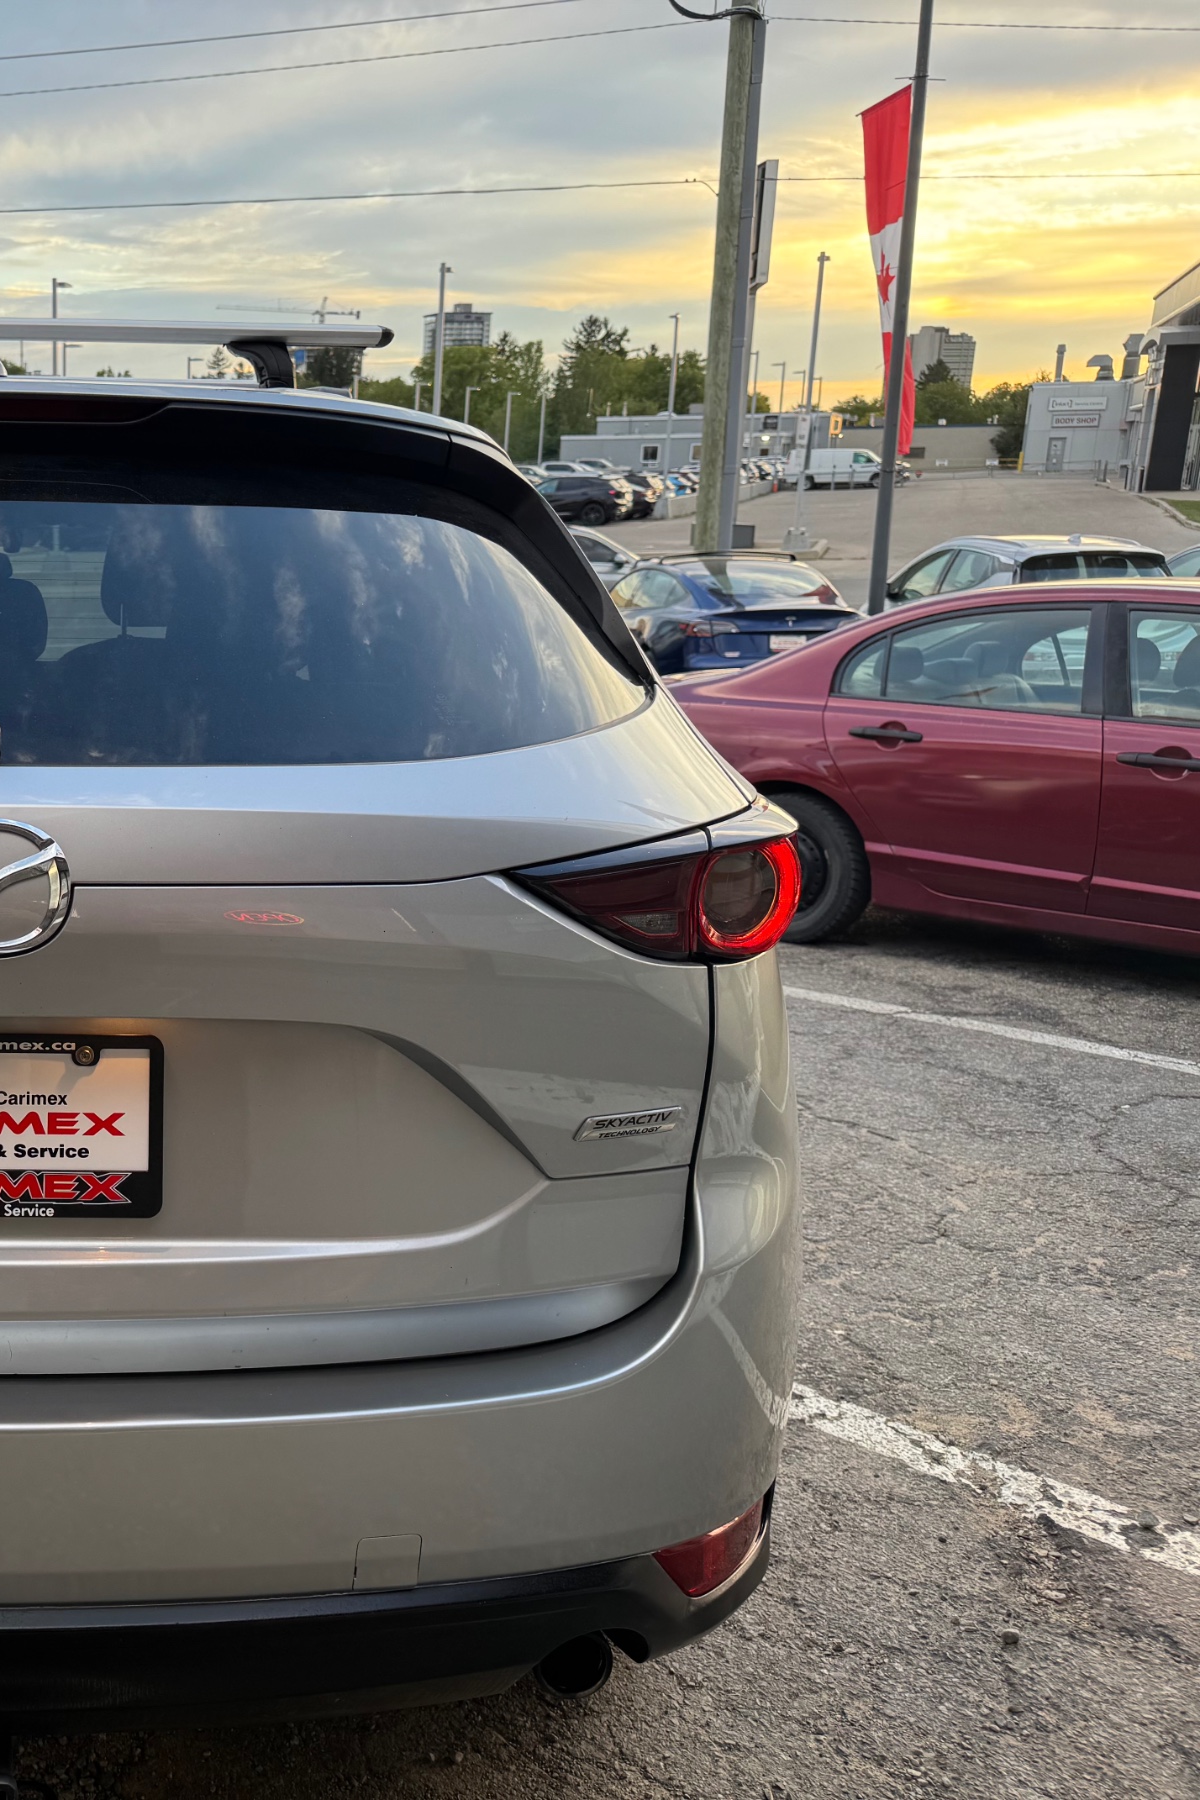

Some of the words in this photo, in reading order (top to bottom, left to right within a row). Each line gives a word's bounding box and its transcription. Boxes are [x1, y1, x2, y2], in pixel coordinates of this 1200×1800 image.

[1055, 417, 1075, 425] BODY
[593, 1111, 673, 1130] SKYACTIV
[598, 1125, 662, 1139] TECHNOLOGY
[13, 1143, 90, 1159] Service
[3, 1203, 55, 1218] Service
